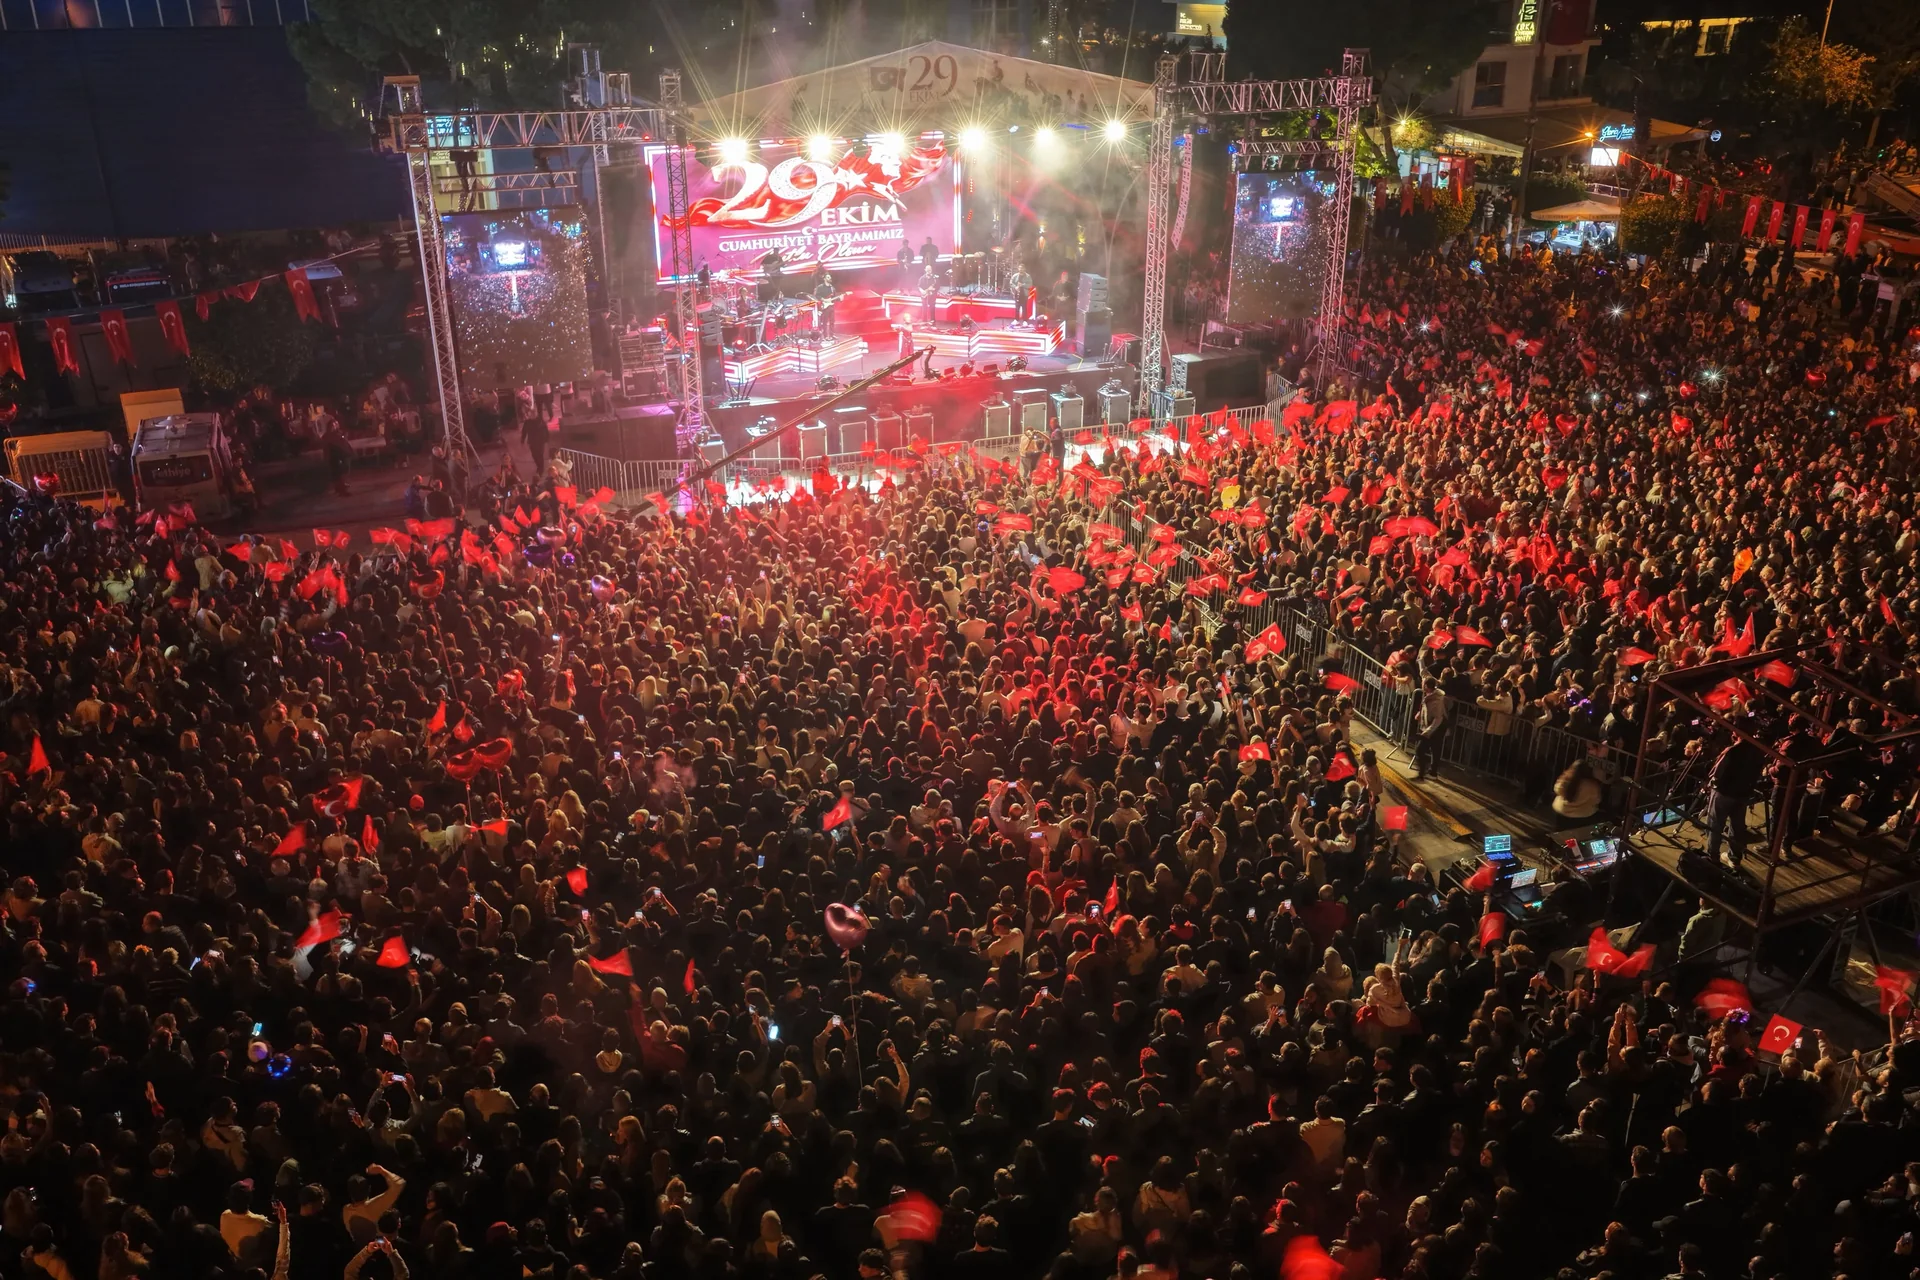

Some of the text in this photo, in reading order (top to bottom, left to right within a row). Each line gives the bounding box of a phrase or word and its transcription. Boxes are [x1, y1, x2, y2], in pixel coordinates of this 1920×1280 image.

[908, 54, 959, 97] 29
[909, 86, 940, 104] EKİM
[707, 156, 838, 228] 29
[819, 201, 901, 226] EKİM
[718, 228, 905, 253] CUMHURİYET BAYRAMIMIZ
[817, 241, 877, 263] Olsun
[152, 465, 191, 479] Fethiye
